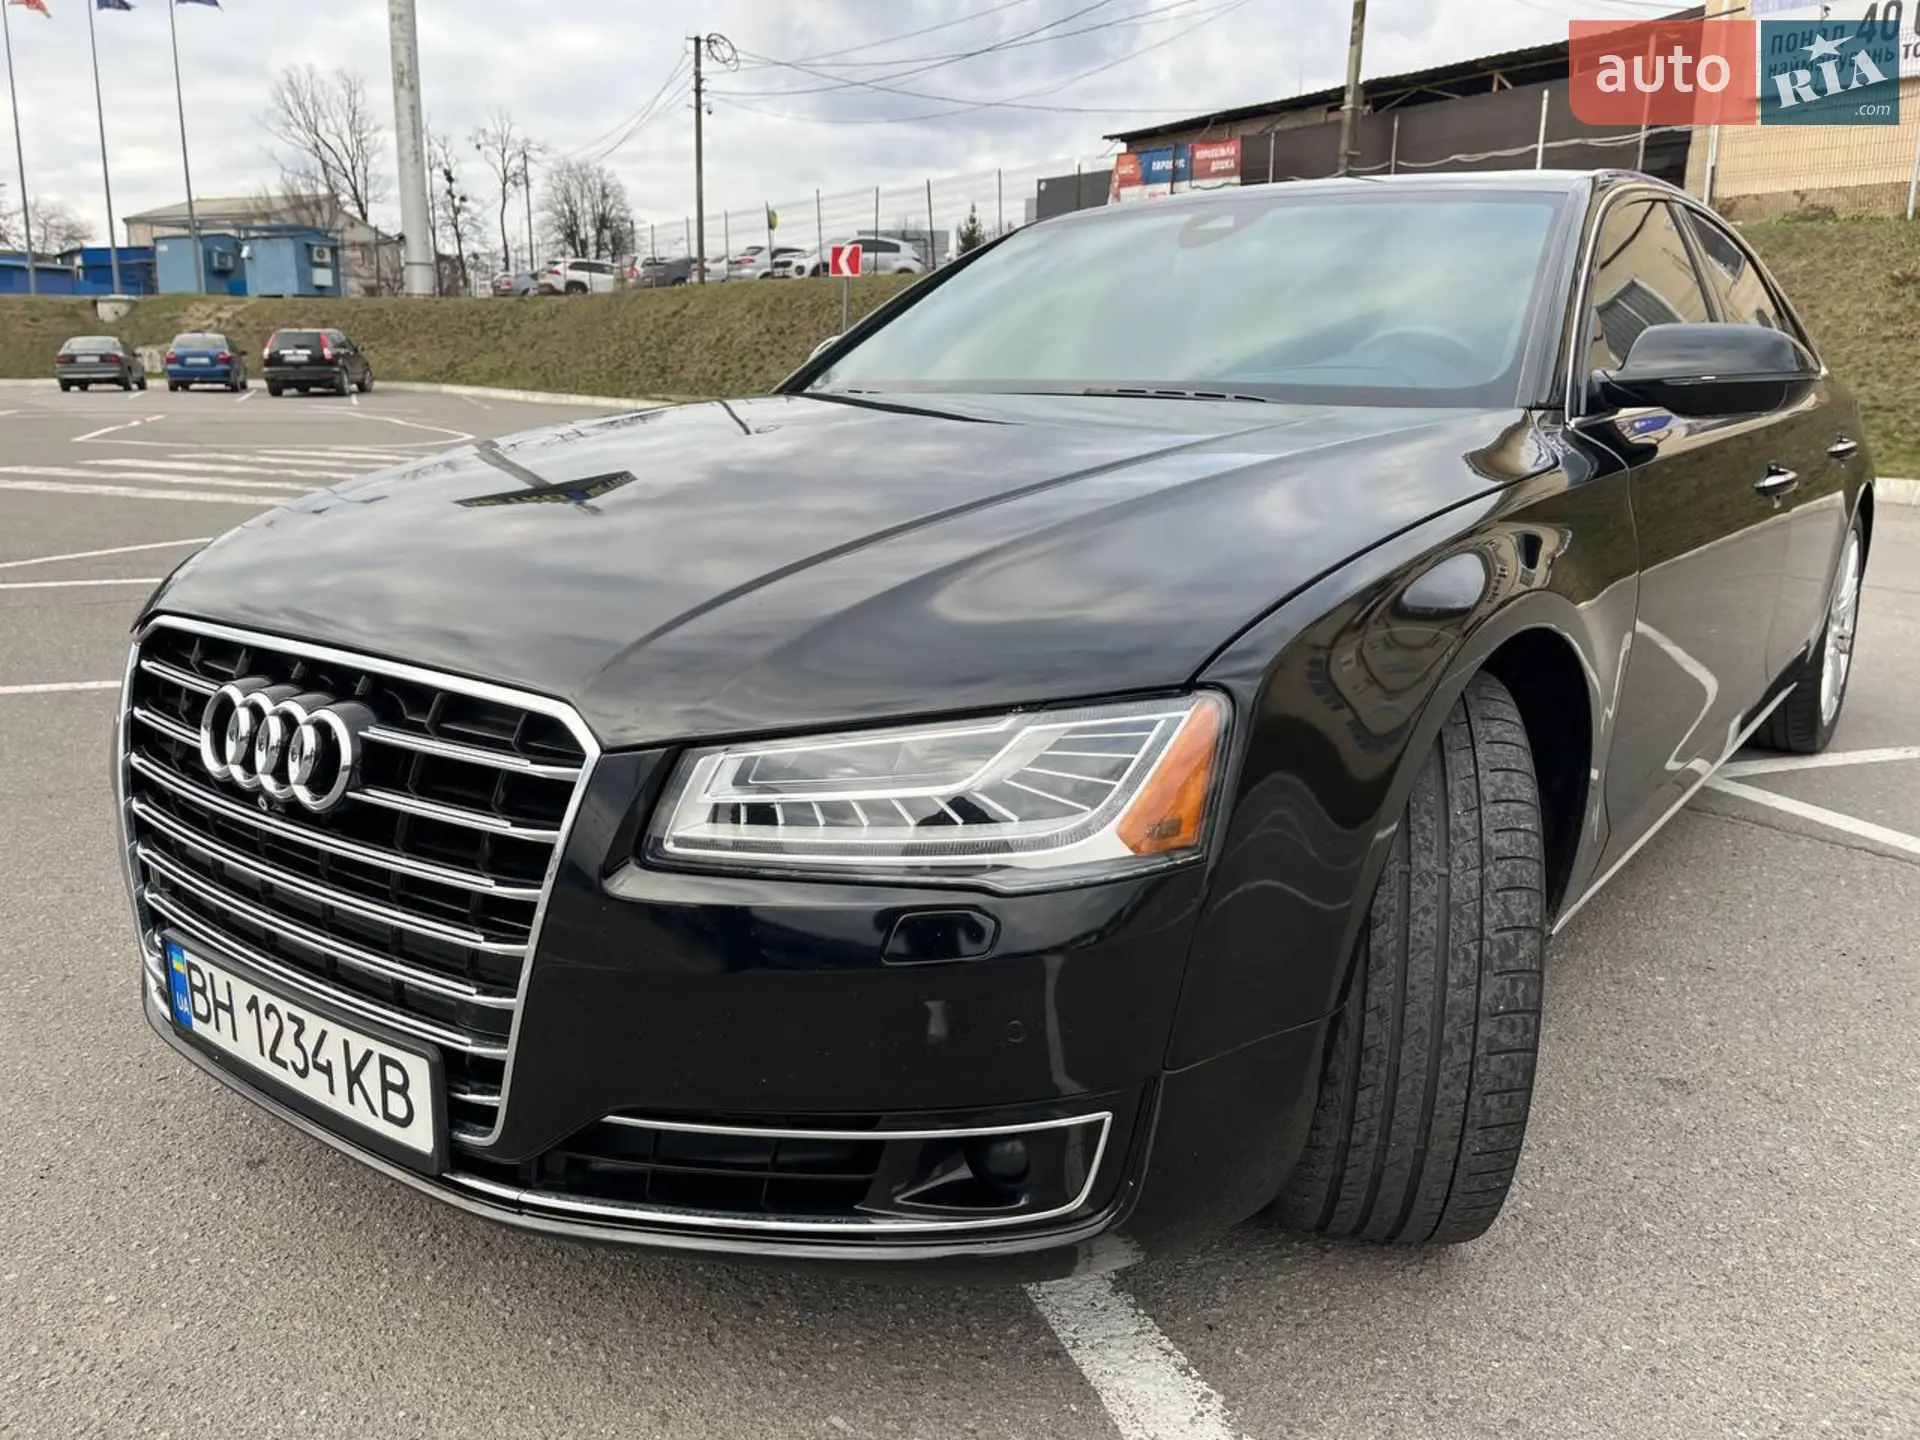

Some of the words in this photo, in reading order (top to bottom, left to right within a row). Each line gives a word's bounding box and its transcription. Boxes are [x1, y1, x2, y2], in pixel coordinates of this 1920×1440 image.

[1856, 0, 1902, 42] 40
[177, 994, 190, 1014] UA
[185, 958, 238, 1042] BH
[246, 994, 335, 1095] 1234
[343, 1038, 415, 1128] KB
